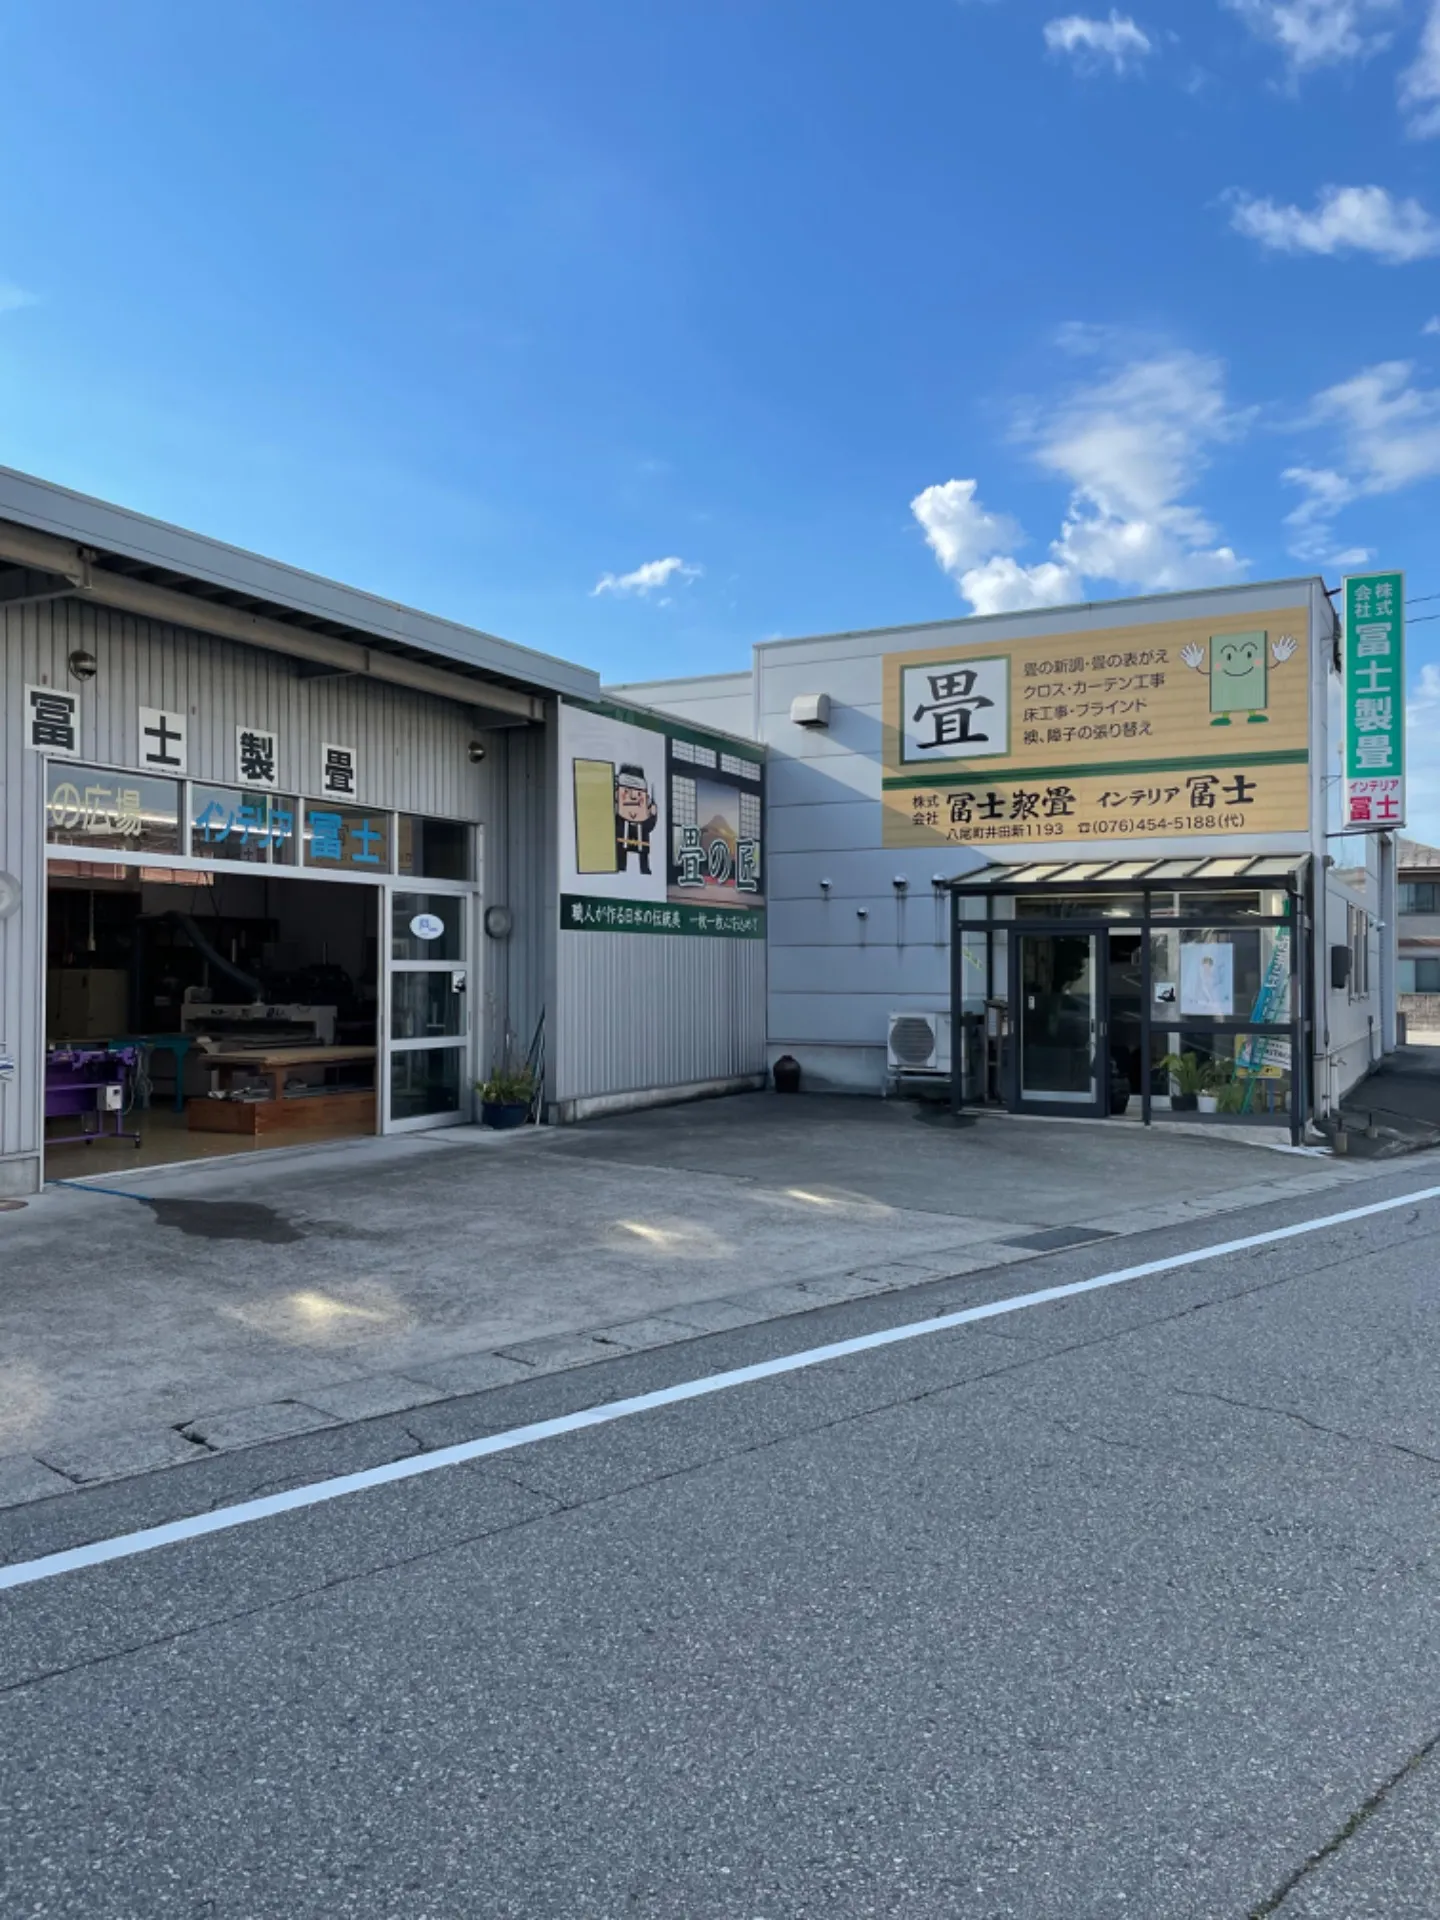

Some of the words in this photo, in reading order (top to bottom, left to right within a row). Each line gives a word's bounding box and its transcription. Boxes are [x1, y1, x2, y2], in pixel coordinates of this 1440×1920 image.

[912, 669, 996, 750] 畳
[1097, 786, 1181, 808] インテリア
[1348, 779, 1399, 793] インテリア
[51, 781, 142, 837] の広場
[946, 822, 1064, 841] 八尾町井田新1193
[677, 824, 757, 892] 畳の匠
